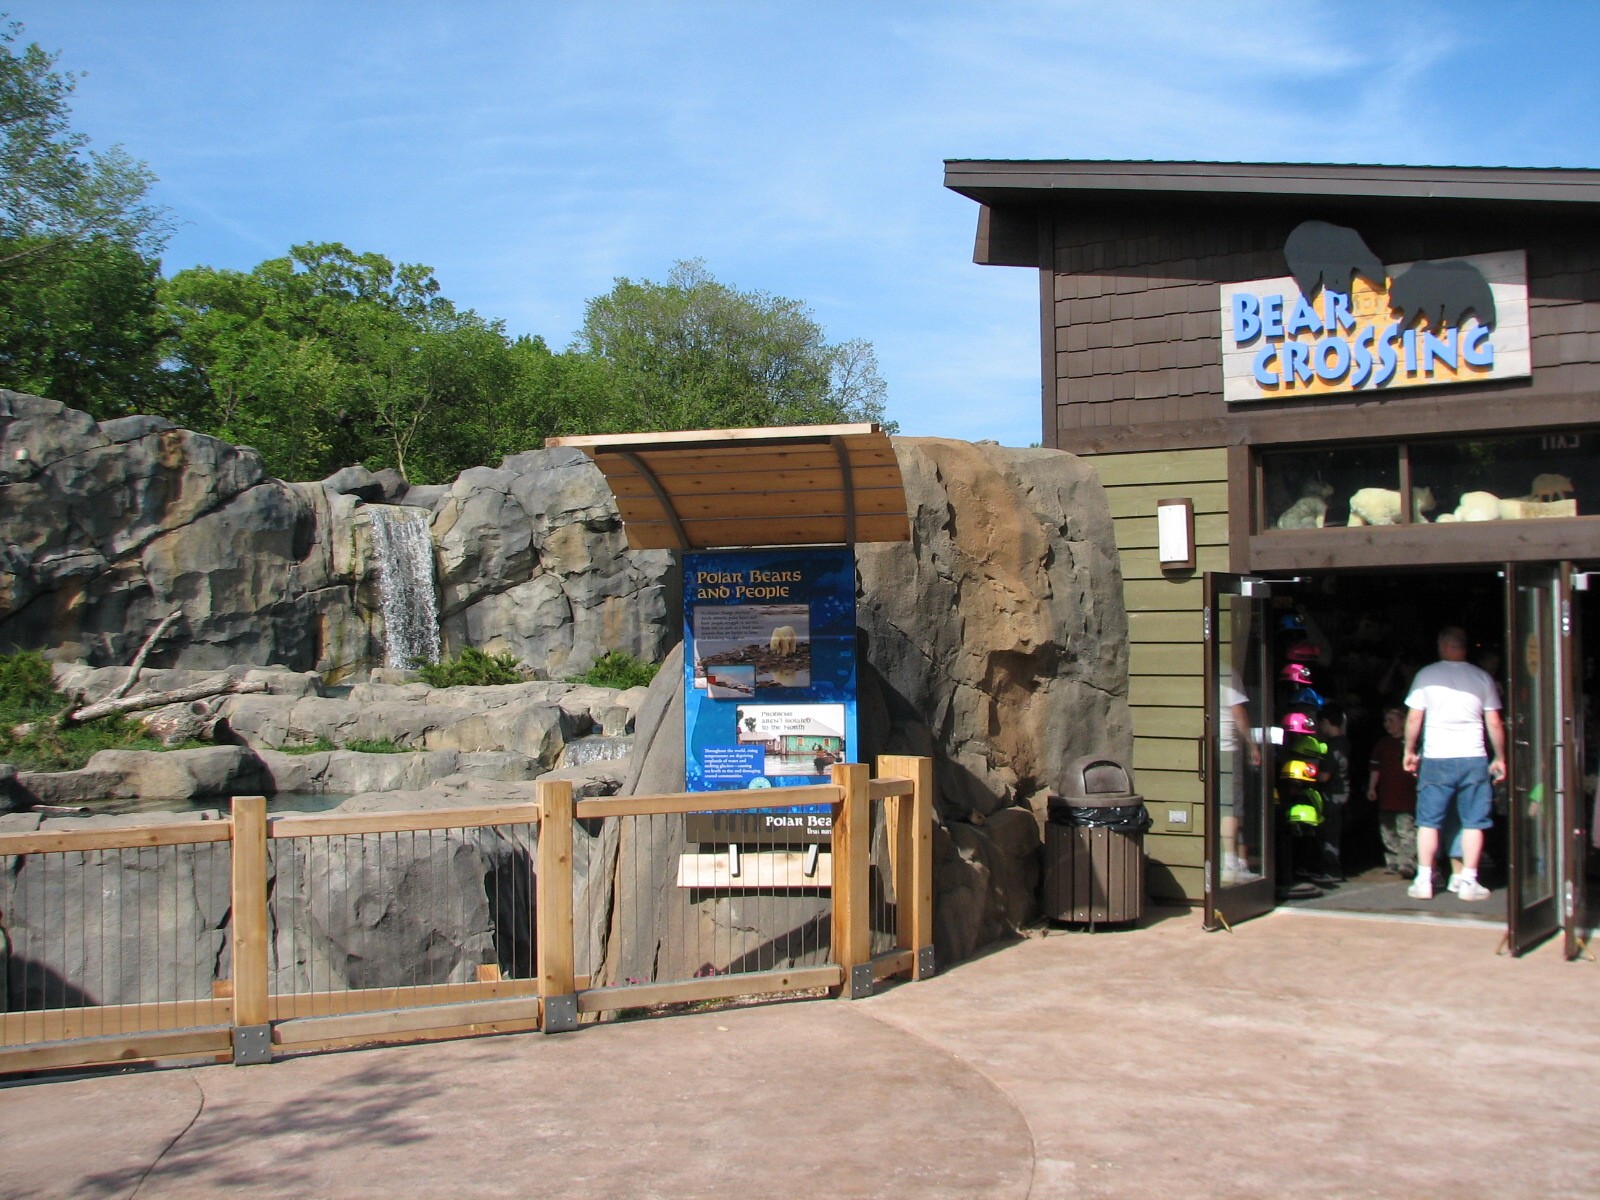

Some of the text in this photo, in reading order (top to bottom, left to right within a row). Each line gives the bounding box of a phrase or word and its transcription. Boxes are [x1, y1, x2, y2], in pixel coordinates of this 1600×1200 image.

[1231, 288, 1356, 343] BEAR
[1252, 322, 1494, 388] CROSSING
[697, 570, 802, 584] Polar Bears
[697, 585, 790, 599] and People
[765, 815, 832, 826] Polar Bea
